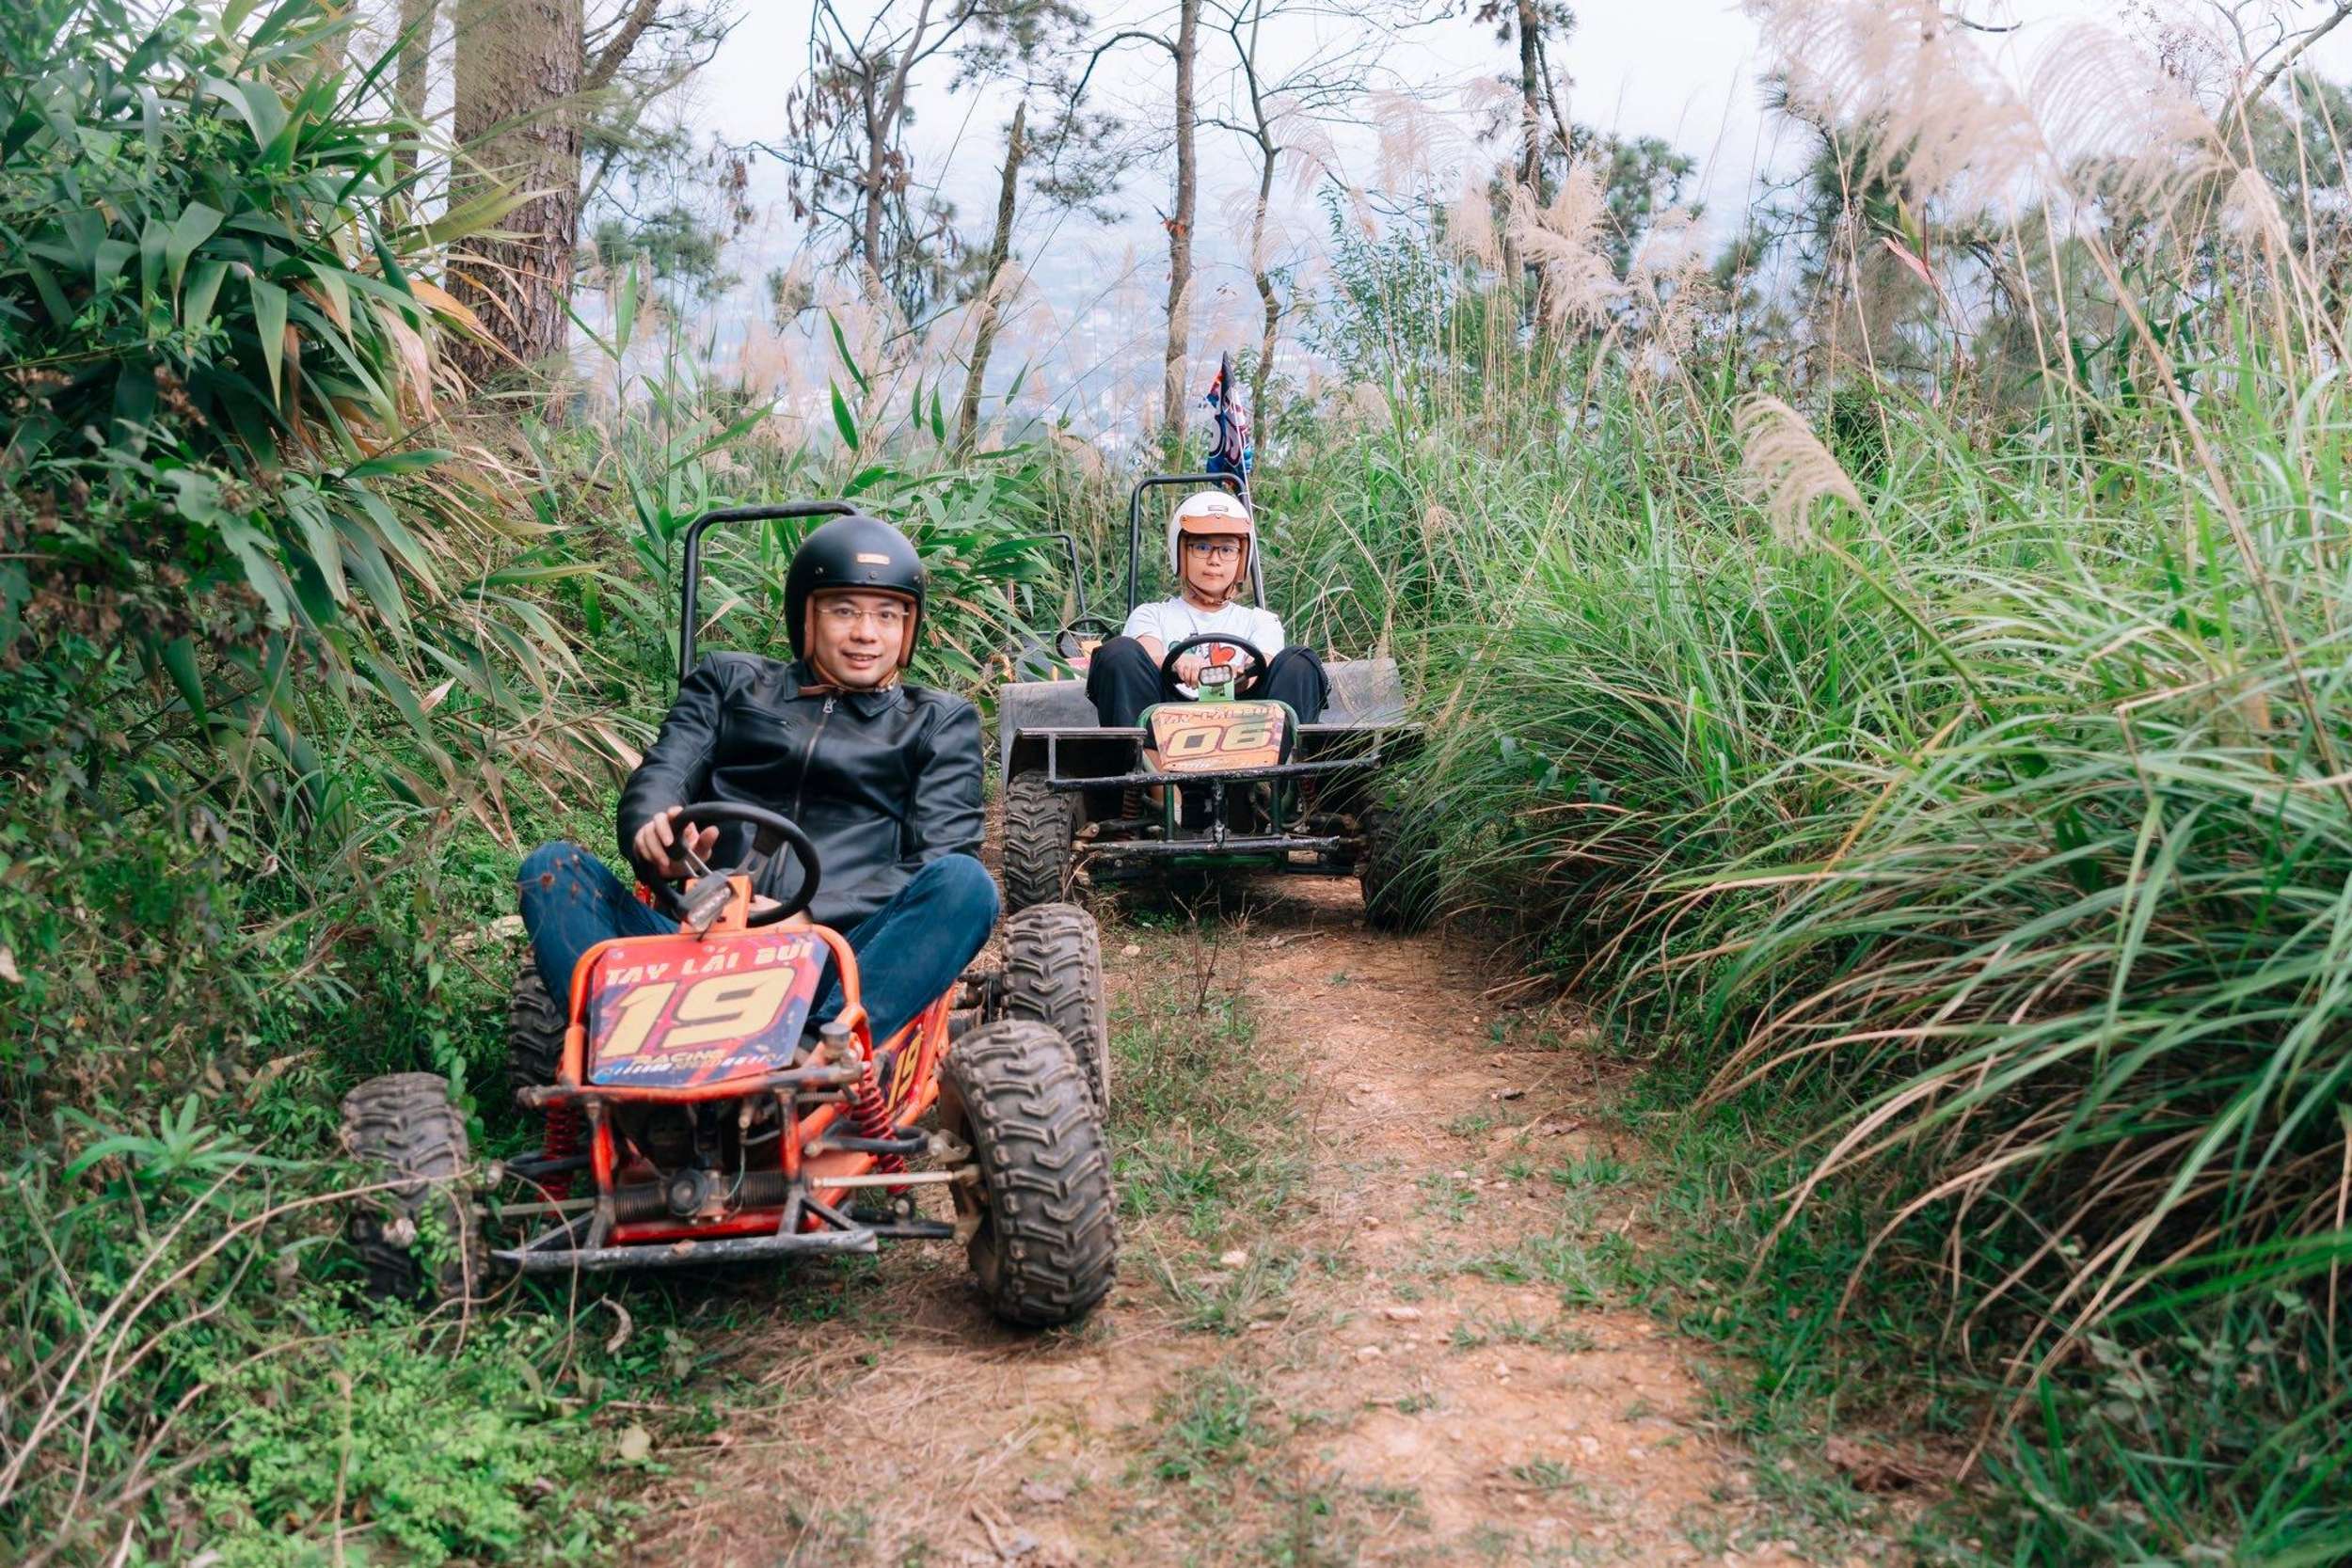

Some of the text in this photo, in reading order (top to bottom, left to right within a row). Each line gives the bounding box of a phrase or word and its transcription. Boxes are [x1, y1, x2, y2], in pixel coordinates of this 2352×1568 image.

[1167, 721, 1272, 757] 06
[604, 962, 670, 987] TAY
[681, 945, 742, 975] LÁI
[599, 967, 796, 1059] 19
[887, 1030, 925, 1112] 19
